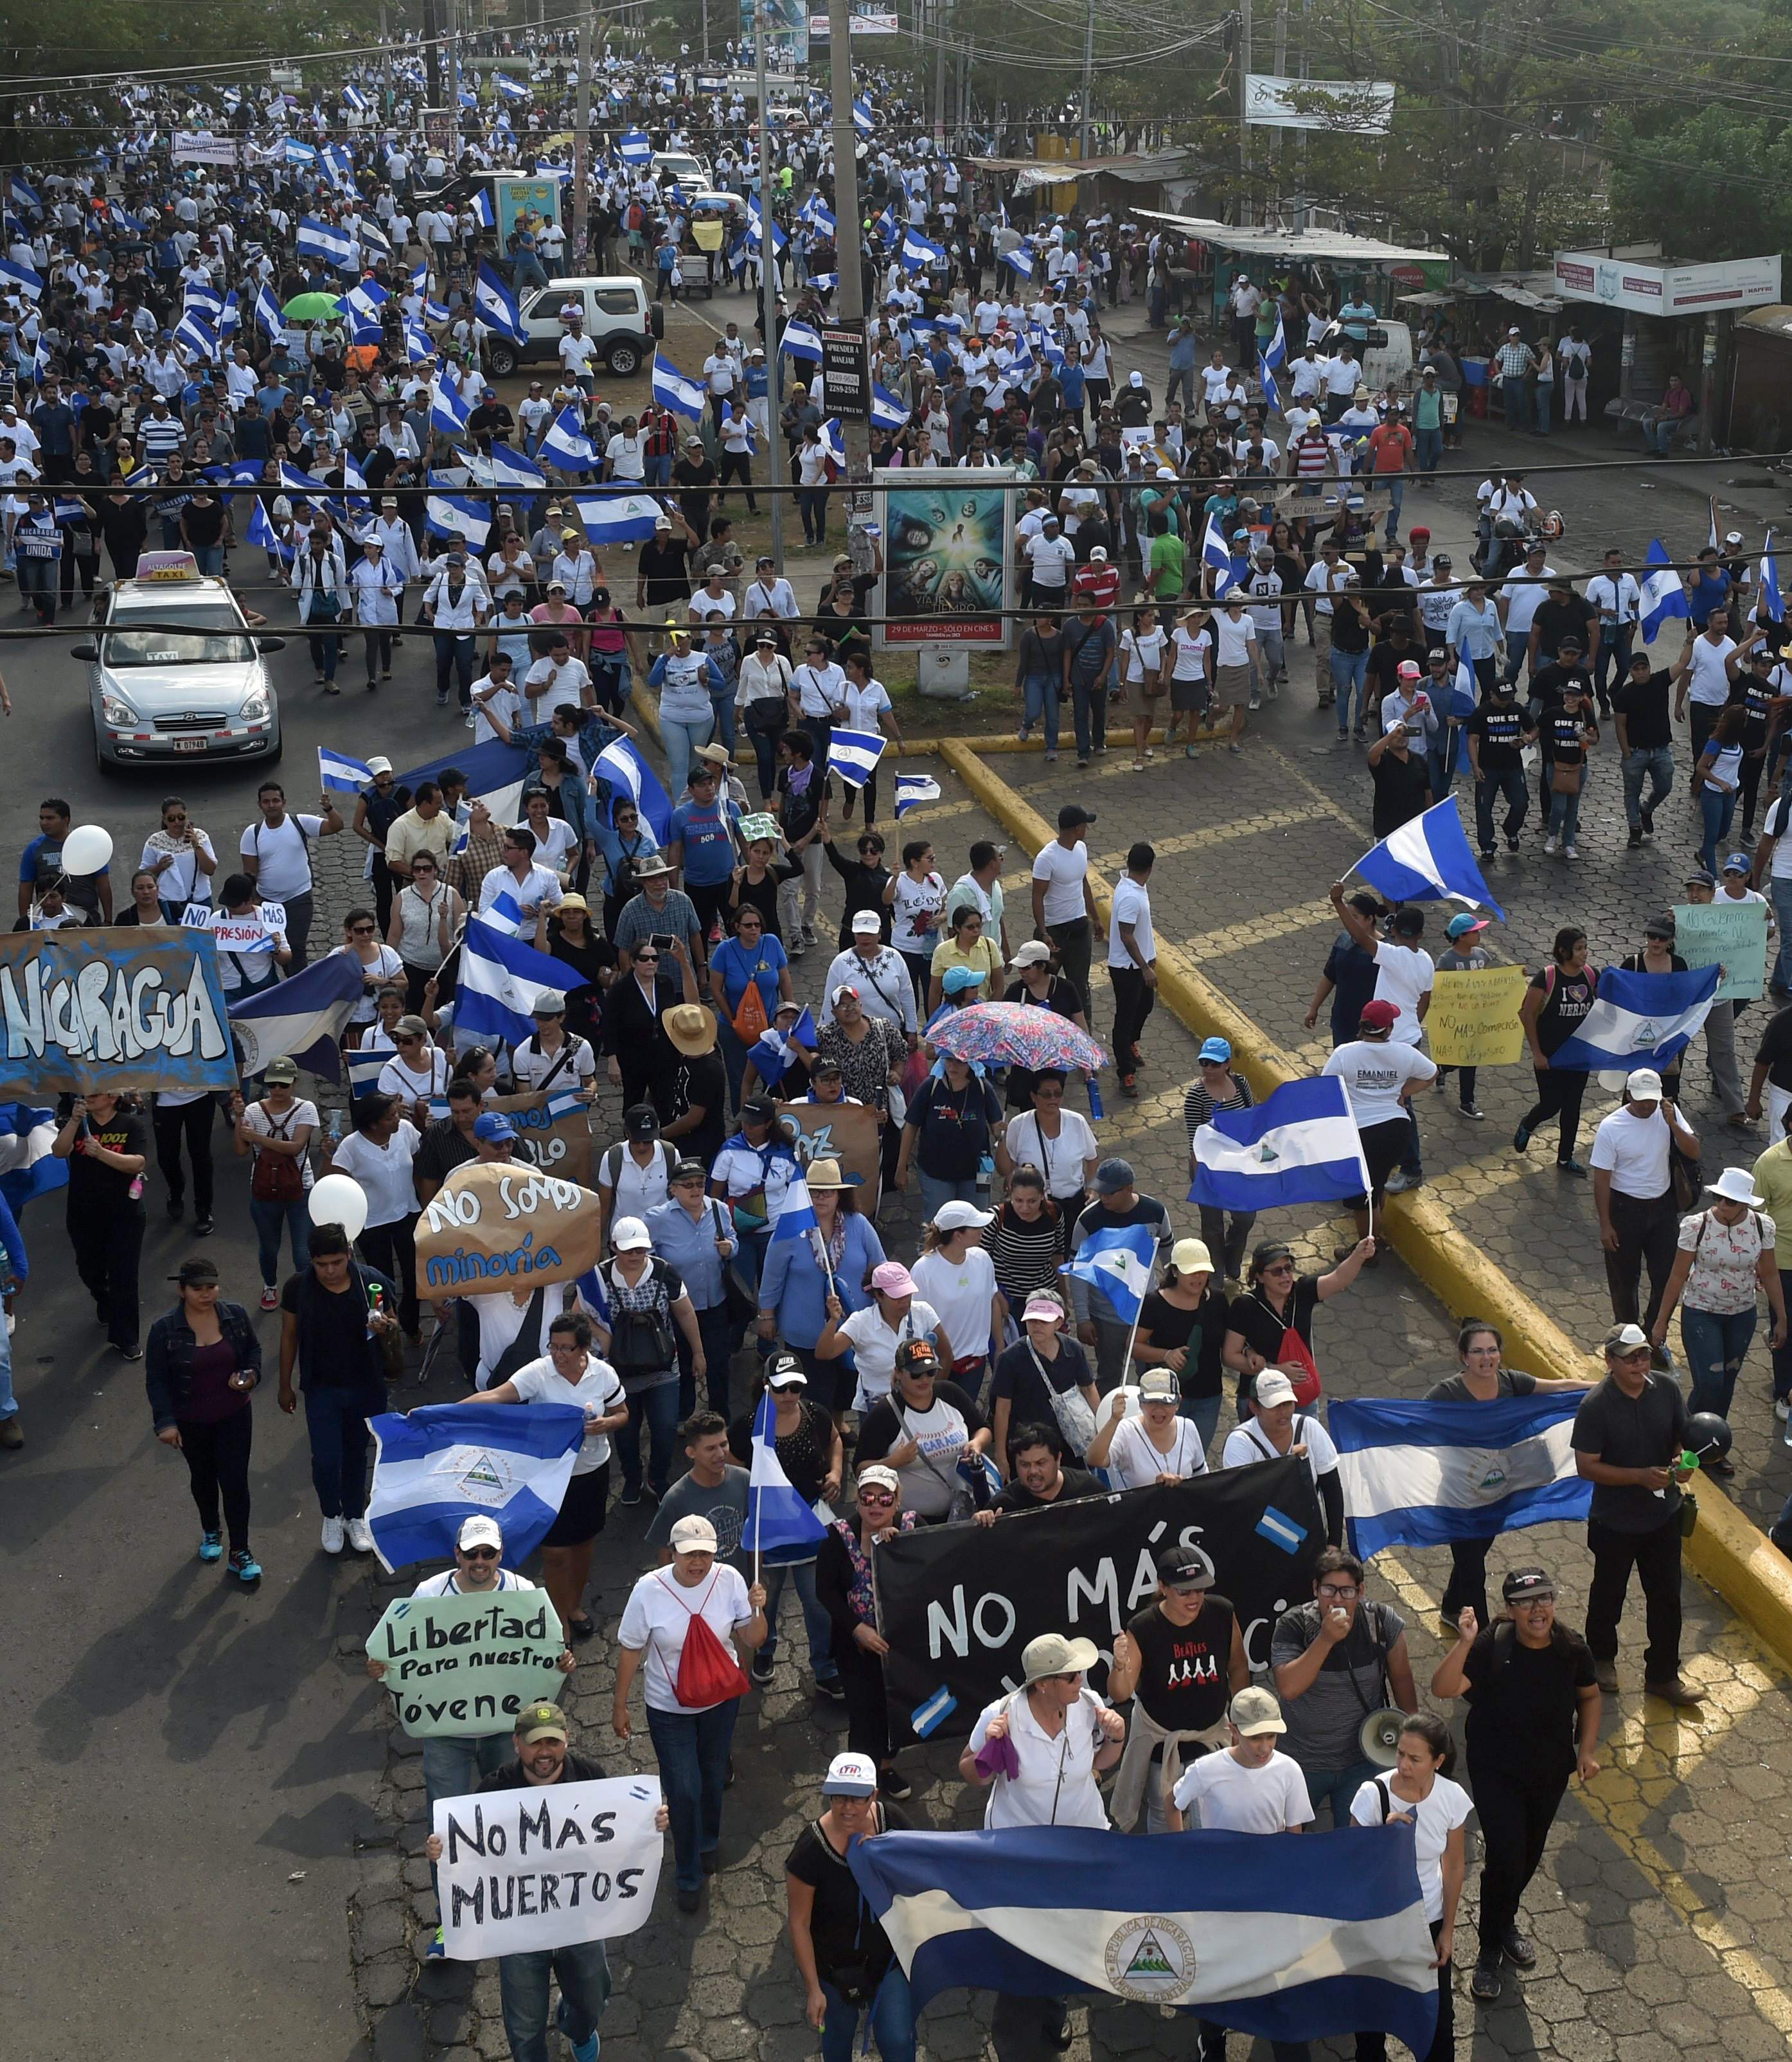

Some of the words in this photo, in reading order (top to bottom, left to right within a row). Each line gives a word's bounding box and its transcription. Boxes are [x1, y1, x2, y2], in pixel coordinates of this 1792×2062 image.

[826, 344, 854, 353] APRENDER
[831, 355, 855, 365] MANEJAR
[21, 529, 58, 537] NICARAGUA
[26, 544, 53, 557] UNIDA
[147, 562, 187, 571] ALTAGOLPE
[915, 596, 945, 605] VIAJE
[932, 603, 976, 612] TIEMPO
[184, 741, 204, 749] 07940
[185, 907, 207, 927] NO
[263, 906, 284, 925] MÁS
[215, 925, 262, 941] PRESIÓN
[1562, 987, 1568, 1002] I
[1, 952, 226, 1062] NICARAGUA
[1558, 1002, 1591, 1017] NERDS
[1439, 1015, 1456, 1029] NO
[1453, 1024, 1476, 1039] MAS
[1357, 1070, 1398, 1078] EMANUEL
[427, 1189, 481, 1234] NO
[427, 1231, 562, 1286] minoría
[927, 1584, 1016, 1659] NO
[1067, 1520, 1215, 1635] MÁS
[386, 1604, 546, 1658] Libertad
[1173, 1642, 1207, 1659] BEATLES
[400, 1658, 458, 1680] Para
[388, 1690, 548, 1723] Jóvene
[519, 1799, 616, 1856] MÁS
[452, 1869, 644, 1928] MUERTOS
[1106, 1919, 1141, 1964] REPUBLICA
[1144, 1917, 1156, 1928] DE
[1157, 1918, 1194, 1966] NICARAGUA
[1110, 1977, 1148, 2001] AMERICA
[1153, 1978, 1192, 2002] CENTRAL
